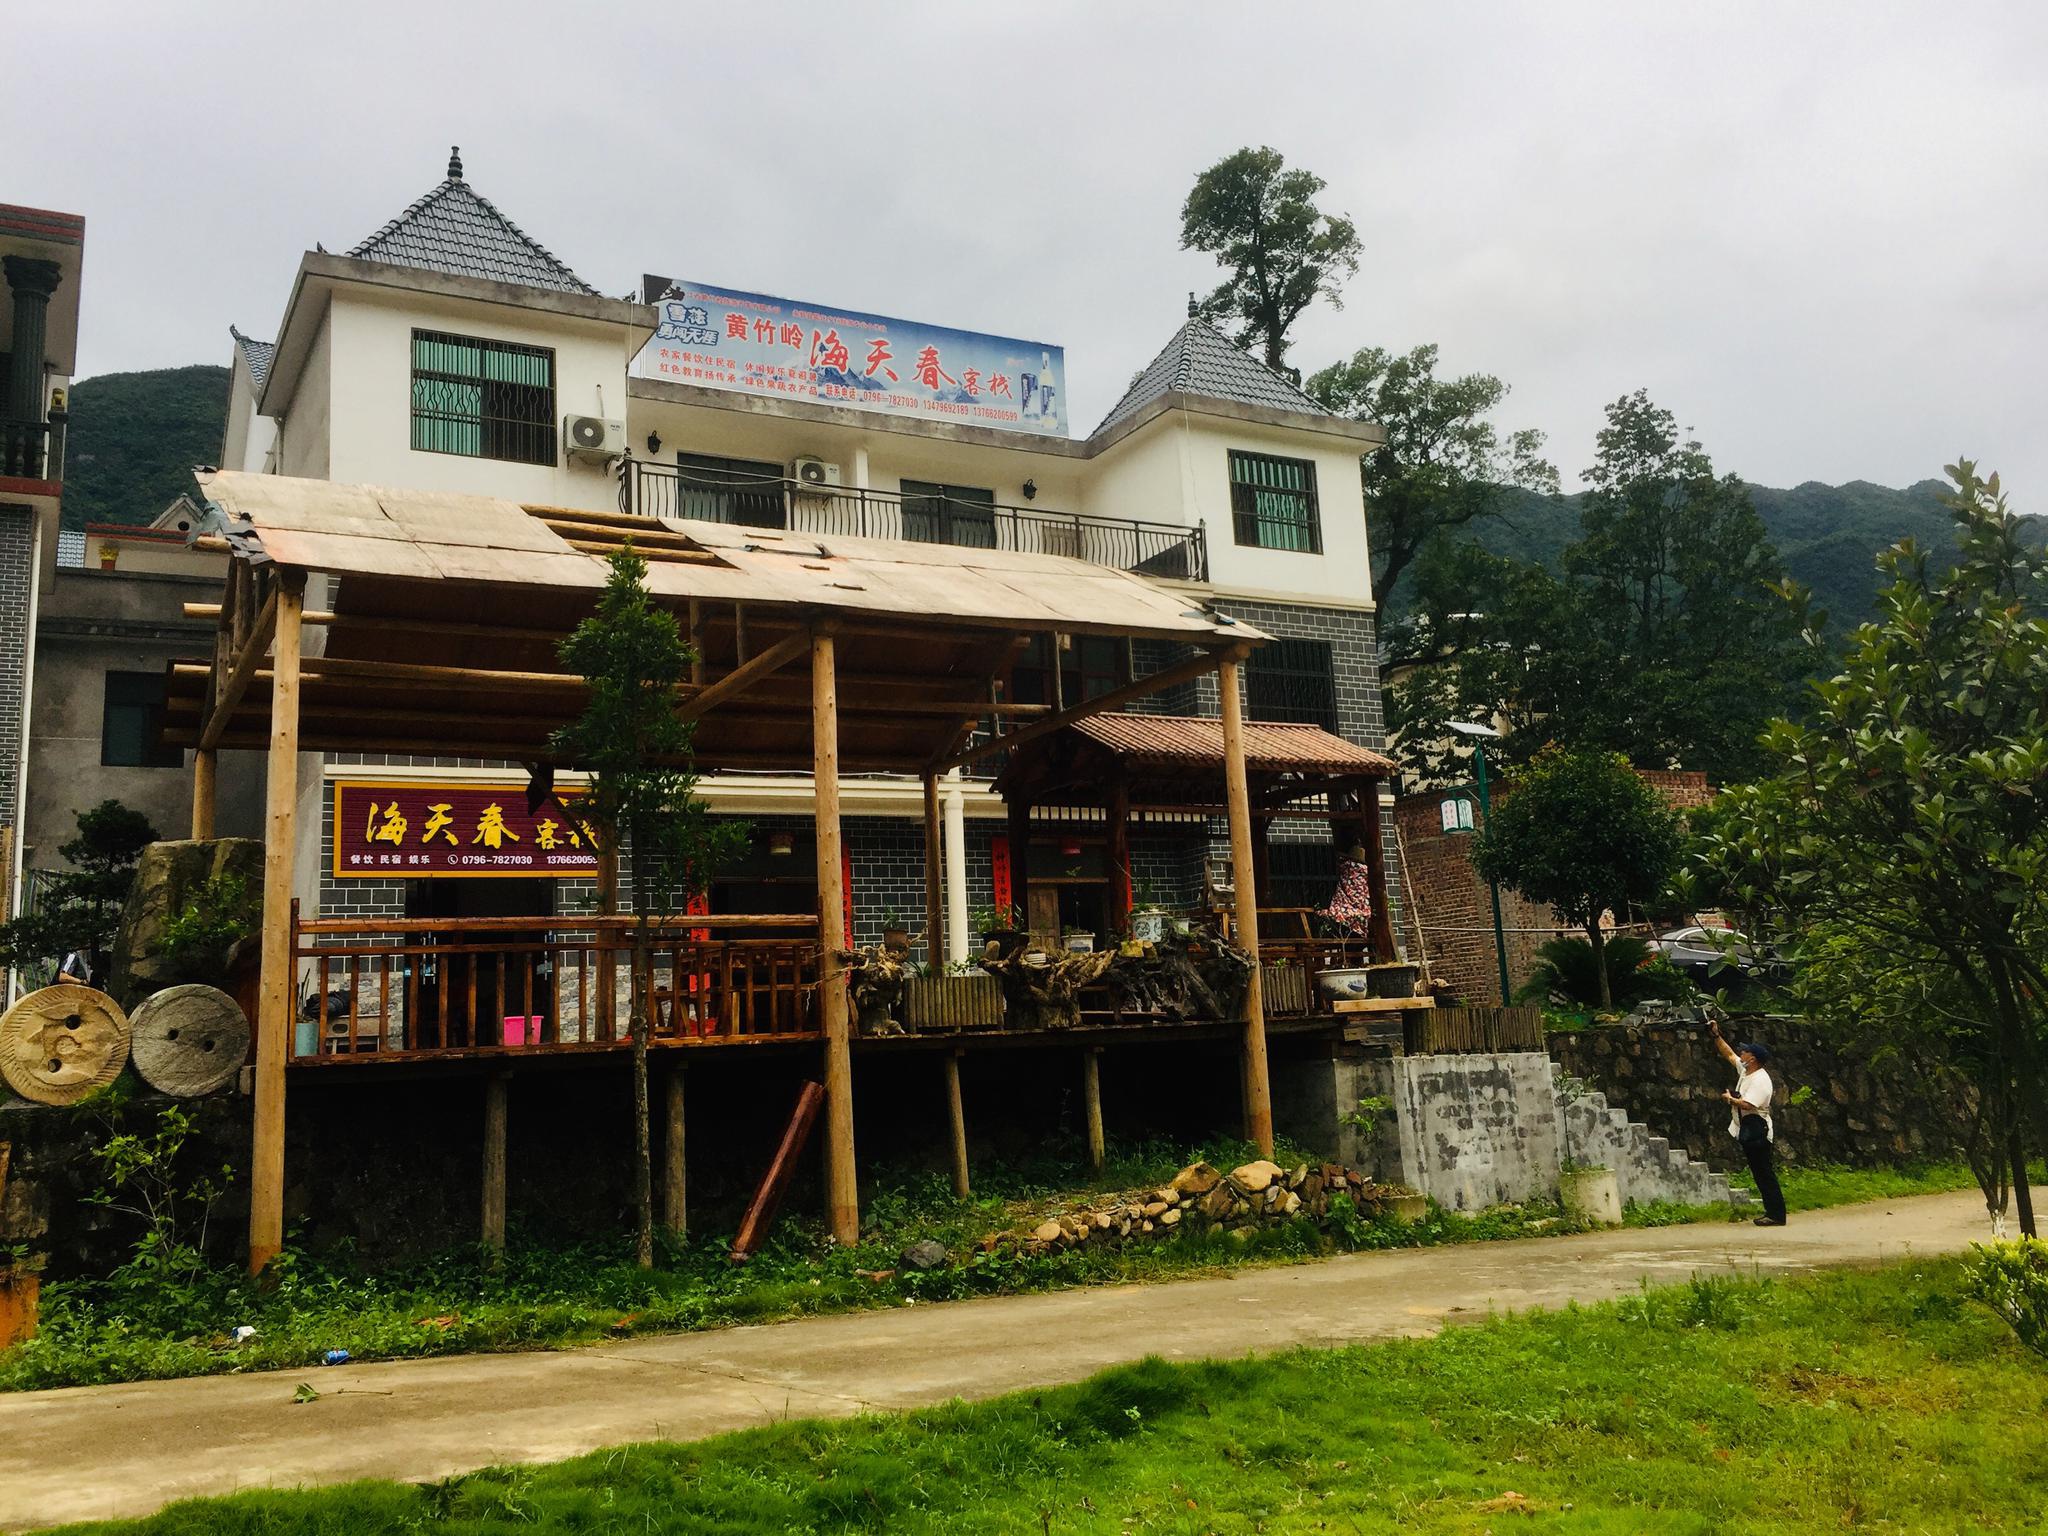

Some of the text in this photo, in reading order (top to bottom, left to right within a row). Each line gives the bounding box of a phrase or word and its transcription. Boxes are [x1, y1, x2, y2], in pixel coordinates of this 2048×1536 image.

[666, 303, 708, 325] 雪花
[656, 322, 719, 346] 勇闯天涯
[660, 348, 736, 369] 农家餐饮住民宿
[744, 376, 818, 395] 绿色果蔬农产品
[825, 384, 856, 400] 联系电话
[923, 400, 969, 416] 13479692189
[973, 407, 1018, 421] 13766200599
[350, 855, 374, 865] 餐饮
[380, 855, 402, 865] 民宿
[408, 855, 431, 865] 娱乐
[462, 855, 533, 866] 0796-7827030
